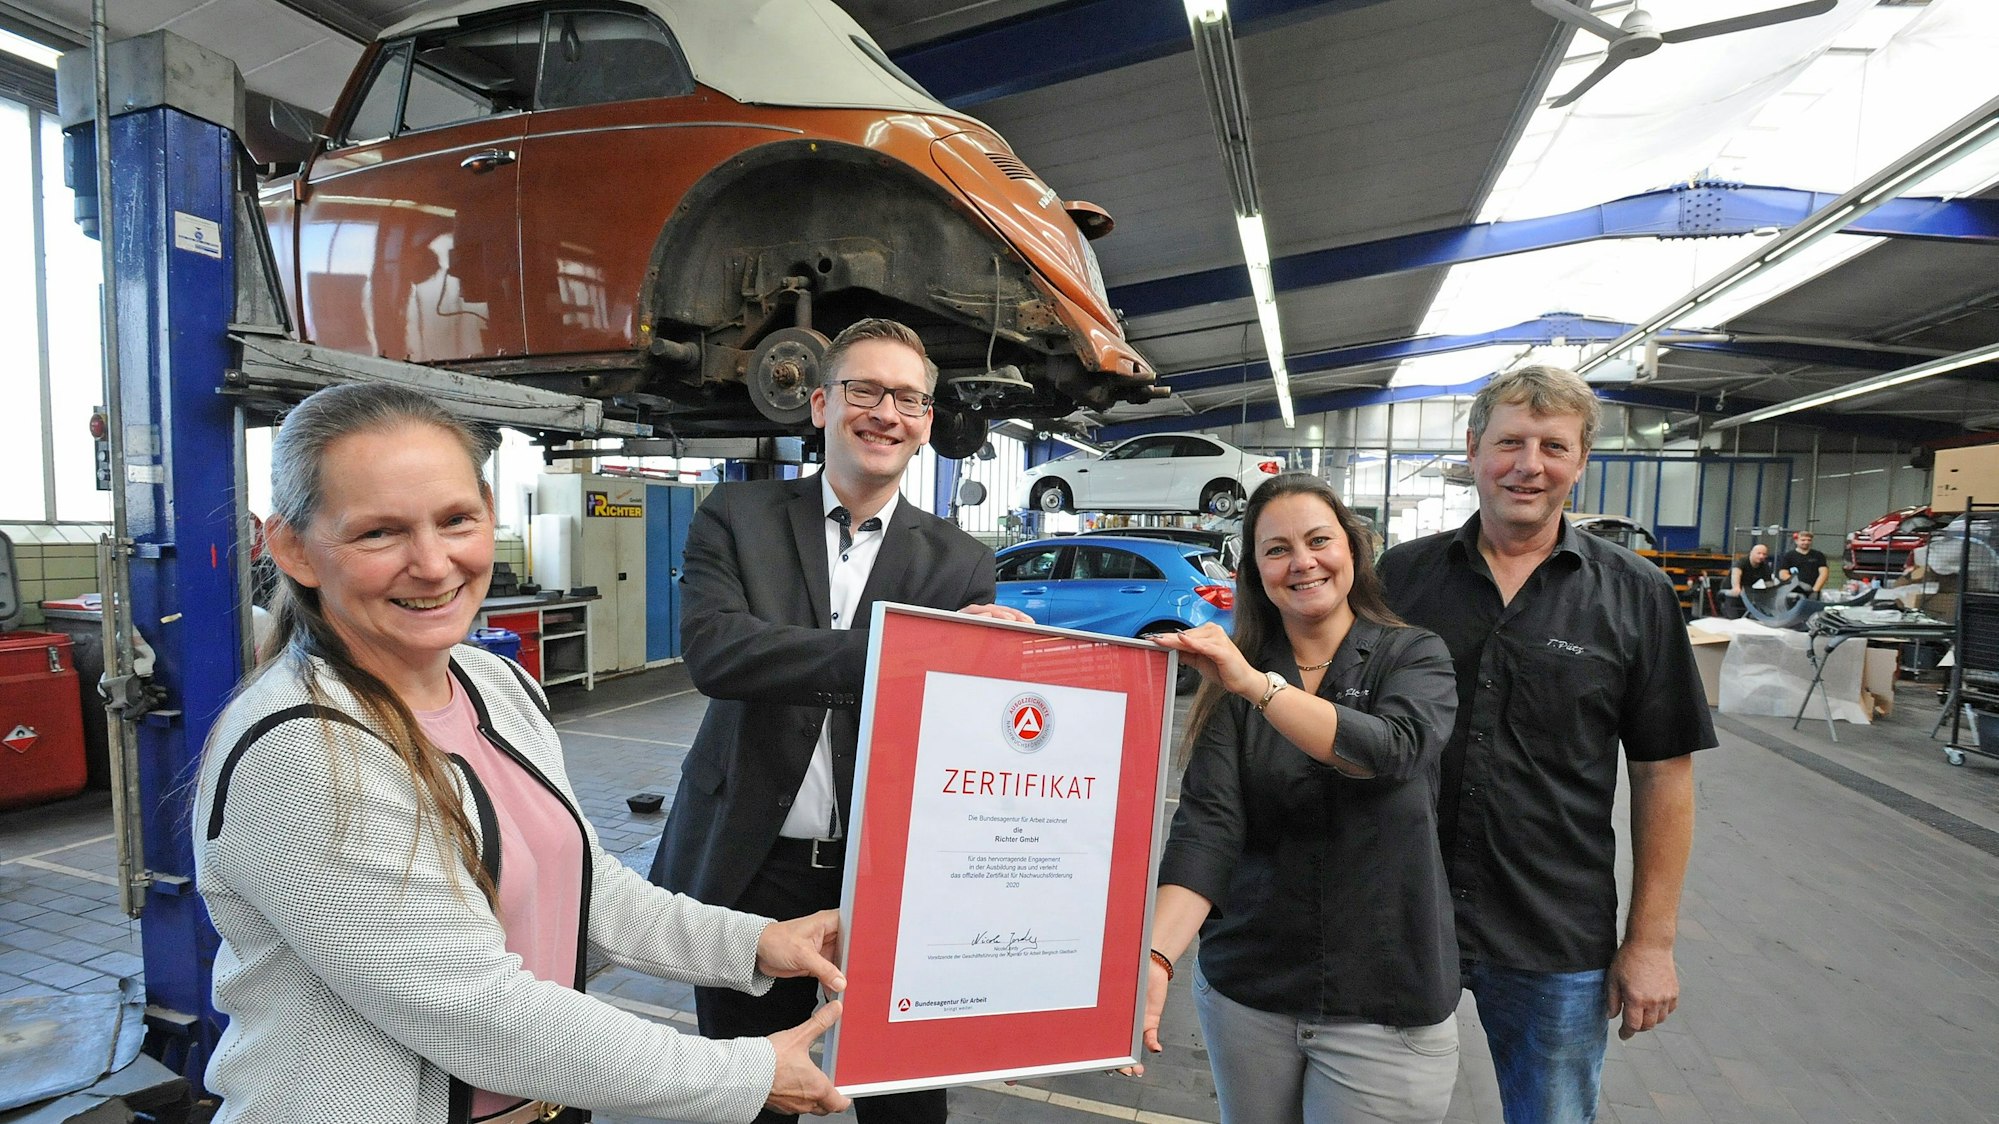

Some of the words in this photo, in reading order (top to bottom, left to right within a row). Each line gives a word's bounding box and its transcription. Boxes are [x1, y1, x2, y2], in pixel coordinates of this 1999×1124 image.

[595, 494, 642, 517] RICHTER
[1009, 697, 1050, 717] AUSGEZEICHNETE
[1006, 720, 1050, 749] NACHWUCHSFÖRDERUNG
[942, 768, 1096, 800] ZERTIFIKAT
[979, 815, 1019, 823] Bundesagentur
[1028, 856, 1061, 864] Engagement
[914, 999, 960, 1008] Bundesagentur
